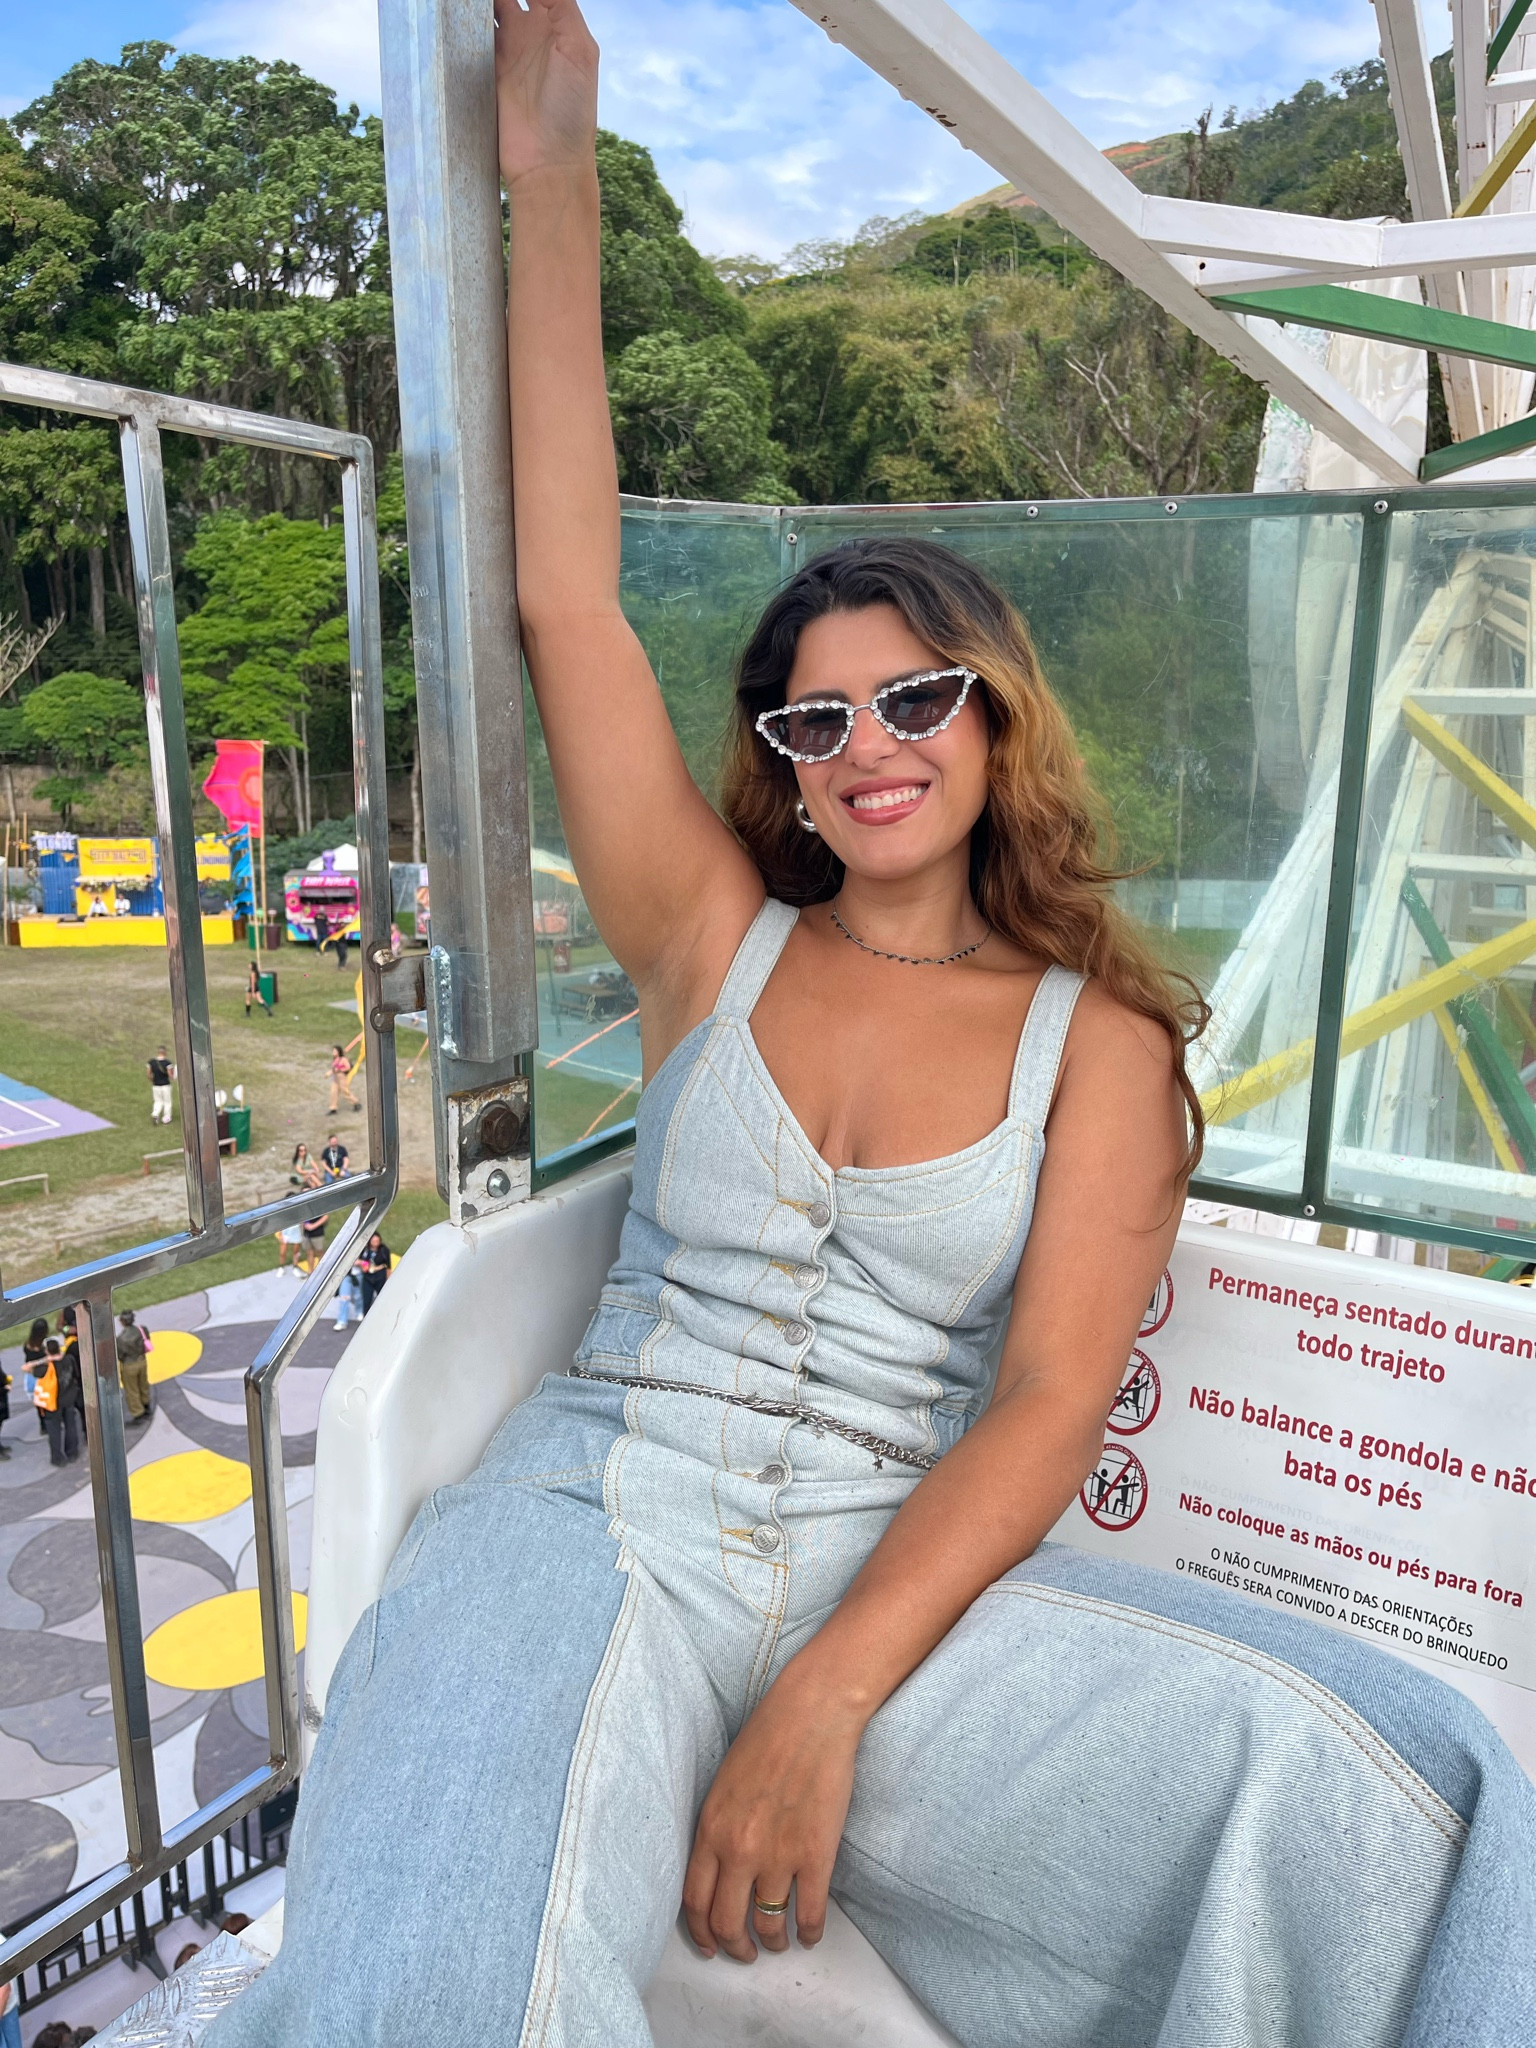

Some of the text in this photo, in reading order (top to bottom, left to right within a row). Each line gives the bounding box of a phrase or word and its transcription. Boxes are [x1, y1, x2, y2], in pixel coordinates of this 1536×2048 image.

[1209, 1268, 1536, 1359] Permaneça sentado duran
[1297, 1330, 1353, 1361] todo
[1361, 1344, 1444, 1382] trajeto
[1189, 1387, 1234, 1417] Não
[1241, 1398, 1333, 1442] balance
[1339, 1430, 1353, 1448] a
[1359, 1435, 1462, 1478] gondola
[1471, 1463, 1486, 1483] e
[1495, 1467, 1536, 1497] não
[1284, 1450, 1337, 1487] bata
[1345, 1475, 1371, 1496] os
[1378, 1482, 1421, 1510] pés
[1179, 1493, 1523, 1607] Não coloque as mãos ou pés para fora
[1211, 1548, 1473, 1637] O NÃO CUMPRIMENTO DAS ORIENTAÇÕES
[1176, 1558, 1508, 1670] O FREGUÊS SERA CONVIDO A DESCER DO BRINQUEDO
